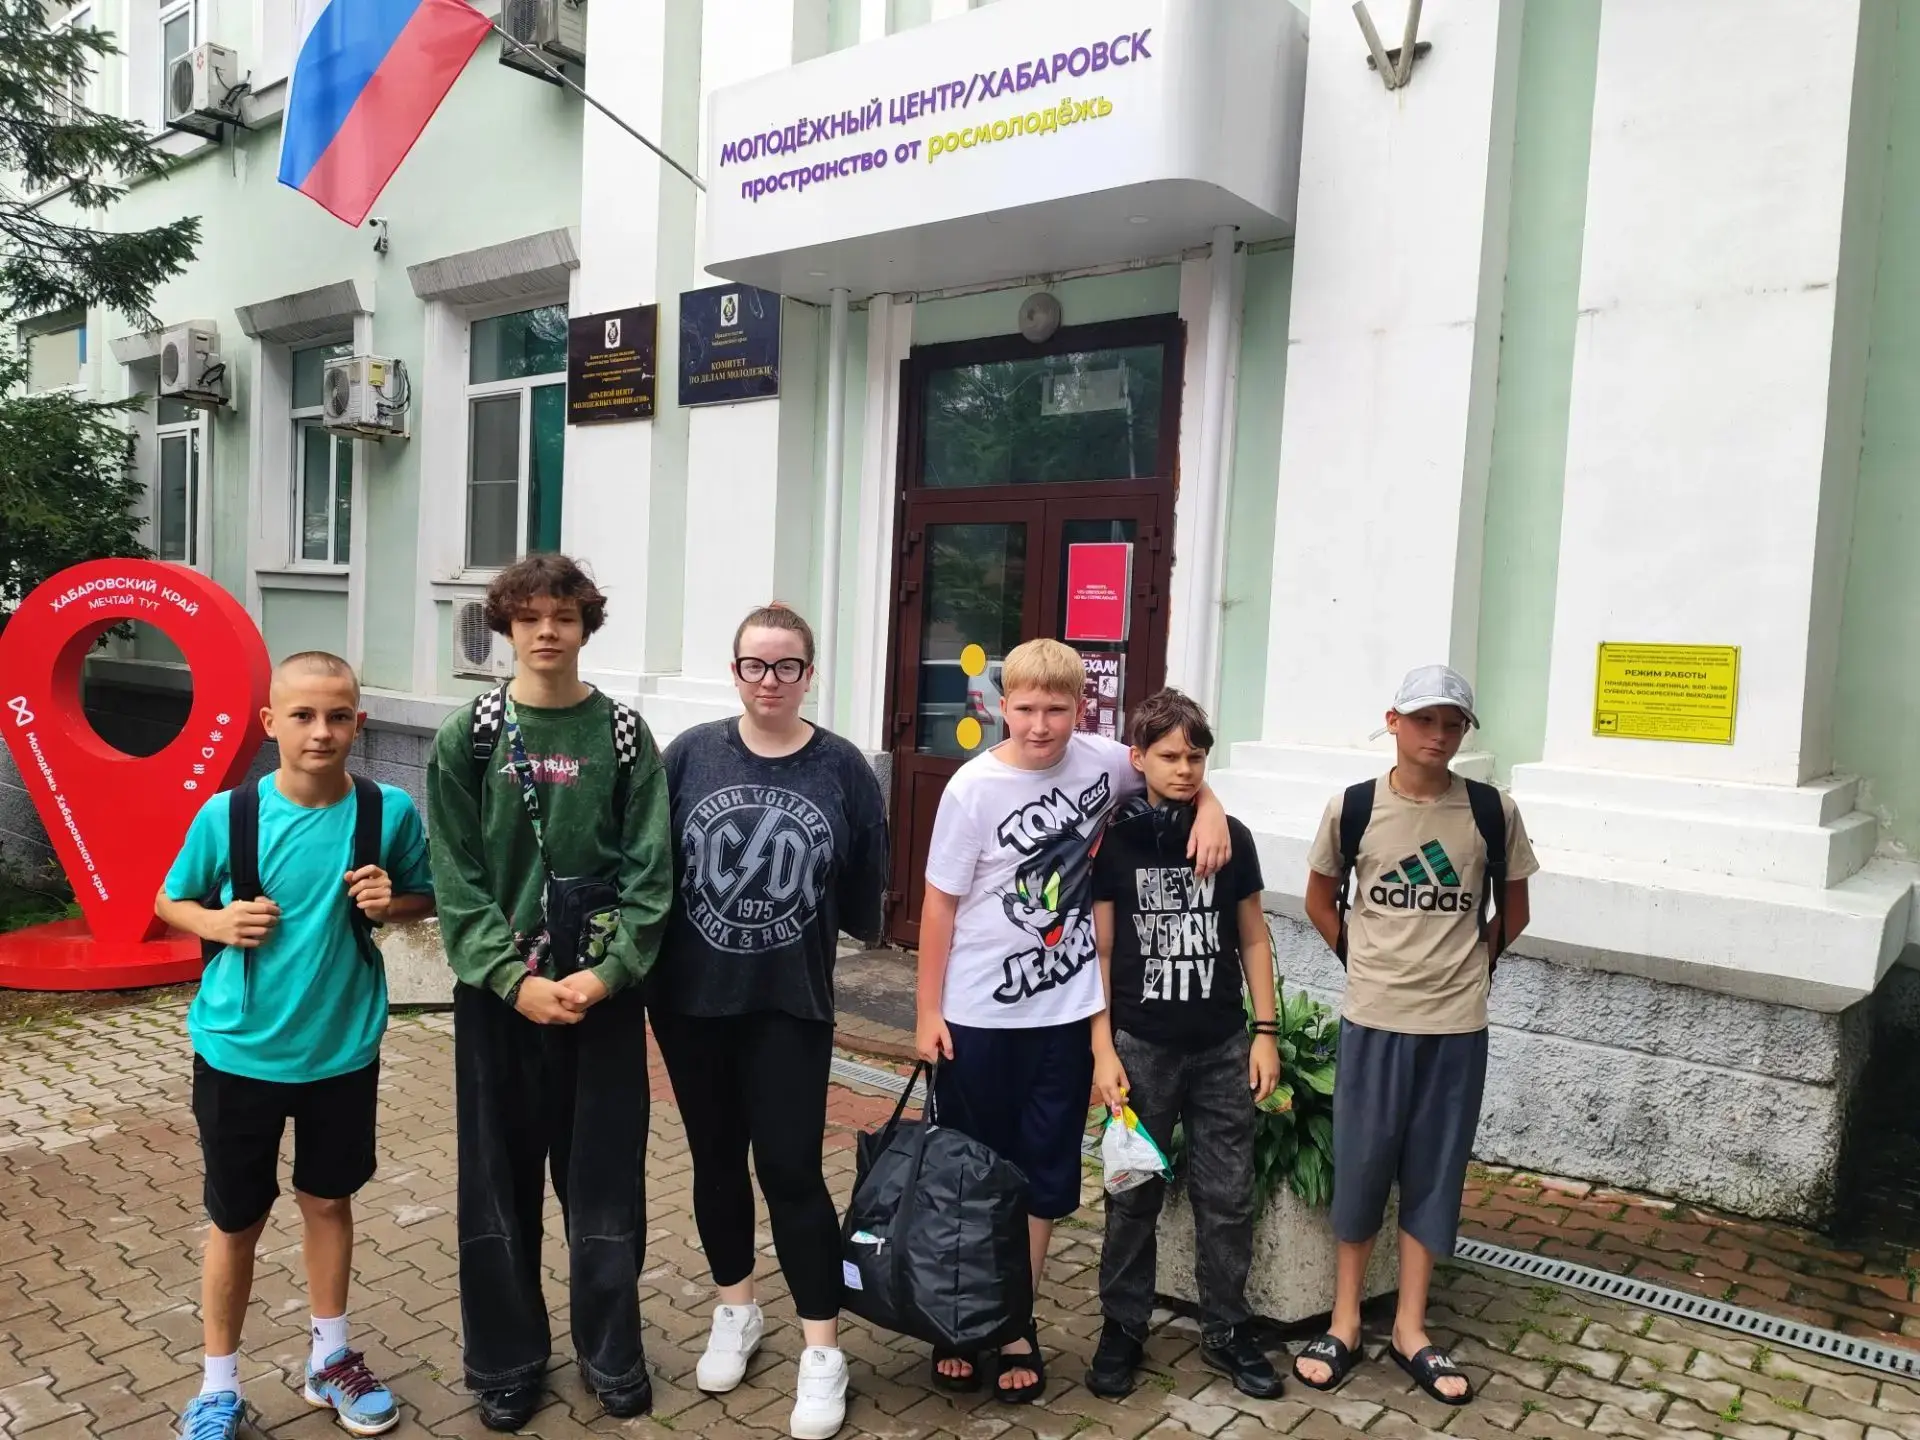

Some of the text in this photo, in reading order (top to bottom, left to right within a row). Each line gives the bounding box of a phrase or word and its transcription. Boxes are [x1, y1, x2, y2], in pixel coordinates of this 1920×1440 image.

[720, 28, 1152, 168] МОЛОДЁЖНЫЙ ЦЕНТР/ХАБАРОВСК
[741, 96, 1113, 203] пространство от росмолодёжь
[50, 577, 199, 617] ХАБАРОВСКИЙ КРАЙ
[88, 594, 161, 611] МЕЧТАЙ ТУТ
[1625, 669, 1706, 680] РЕЖИМ РАБОТЫ
[26, 732, 109, 901] Молодёжь Хабаровского края
[698, 789, 827, 836] HIGH VOLTAGE
[998, 789, 1081, 855] TOM
[737, 898, 774, 920] 1975
[1136, 867, 1216, 910] NEW
[1370, 883, 1473, 912] adidas
[692, 902, 732, 945] ROCK
[1132, 911, 1221, 957] YORK
[1141, 958, 1215, 1003] CITY
[1309, 1342, 1337, 1358] FILA
[1428, 1356, 1456, 1369] FILA
